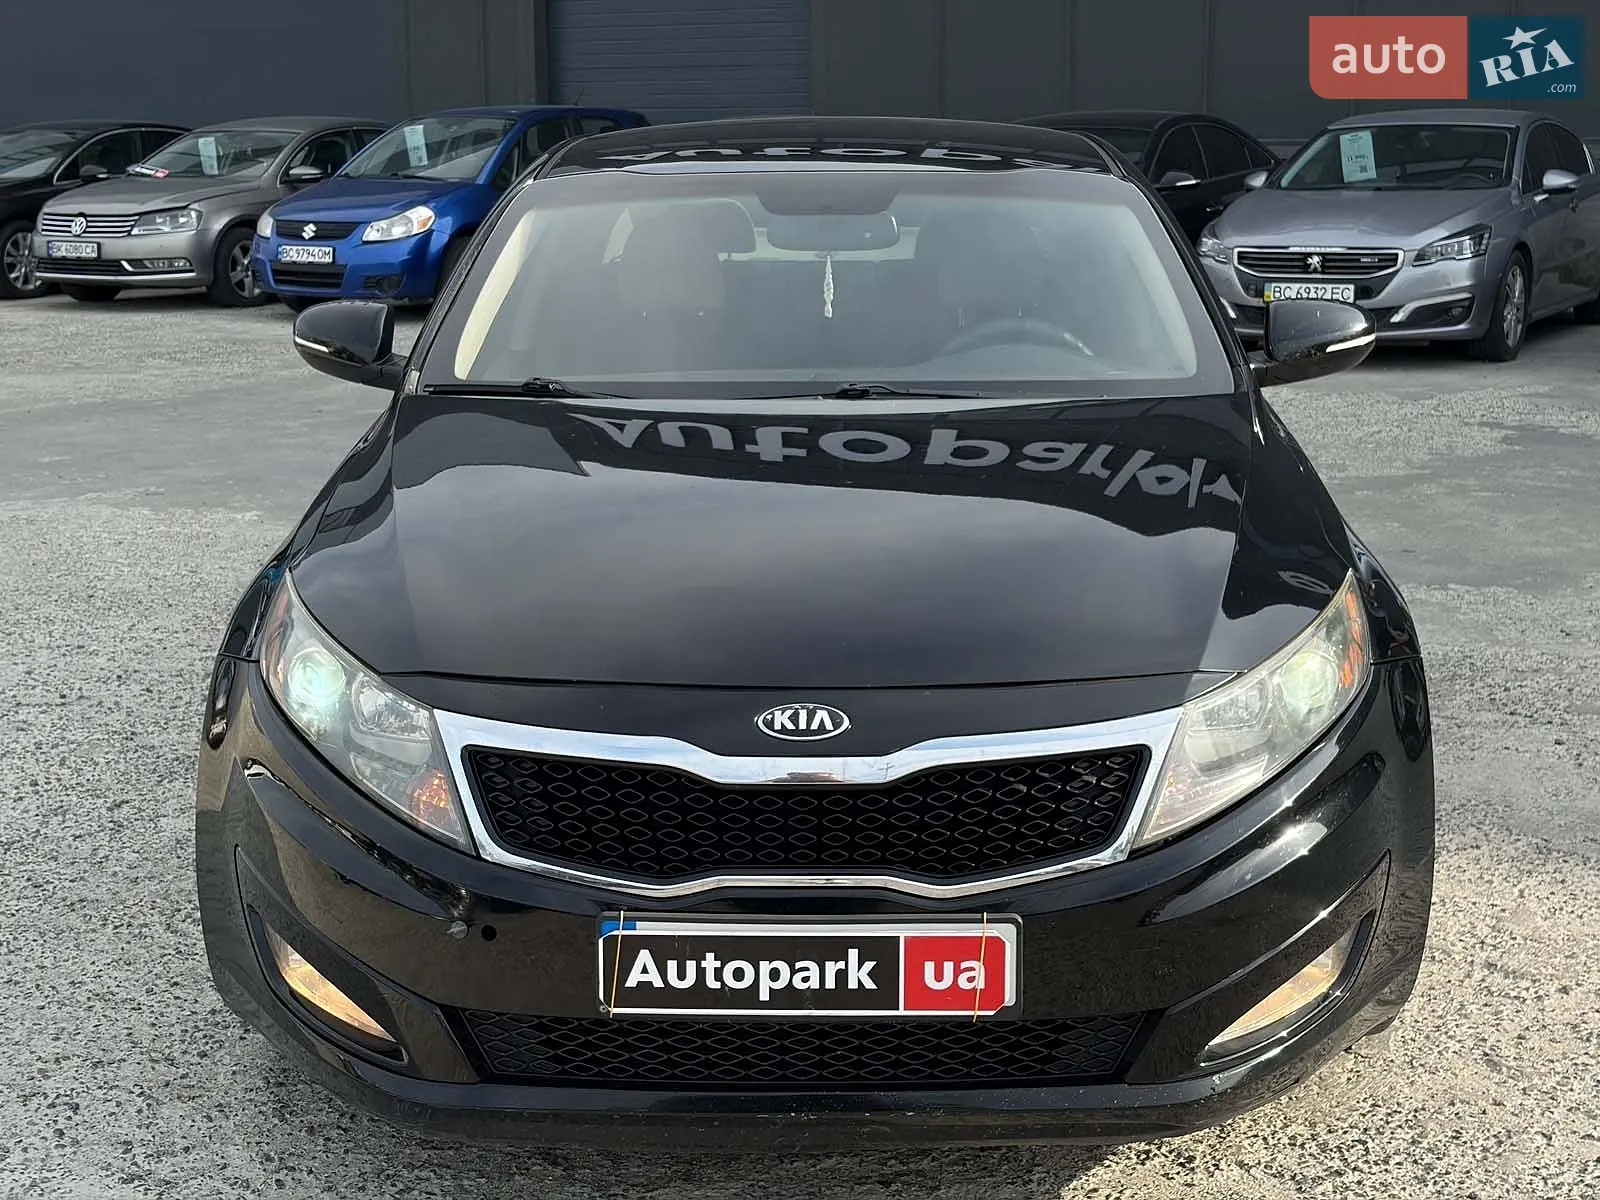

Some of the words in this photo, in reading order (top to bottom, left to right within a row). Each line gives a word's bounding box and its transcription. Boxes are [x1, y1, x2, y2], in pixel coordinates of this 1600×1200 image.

[1272, 286, 1292, 300] BC
[1296, 286, 1327, 300] 6932
[773, 709, 834, 731] KIA
[624, 948, 878, 1001] Autopark
[923, 960, 986, 990] ua
